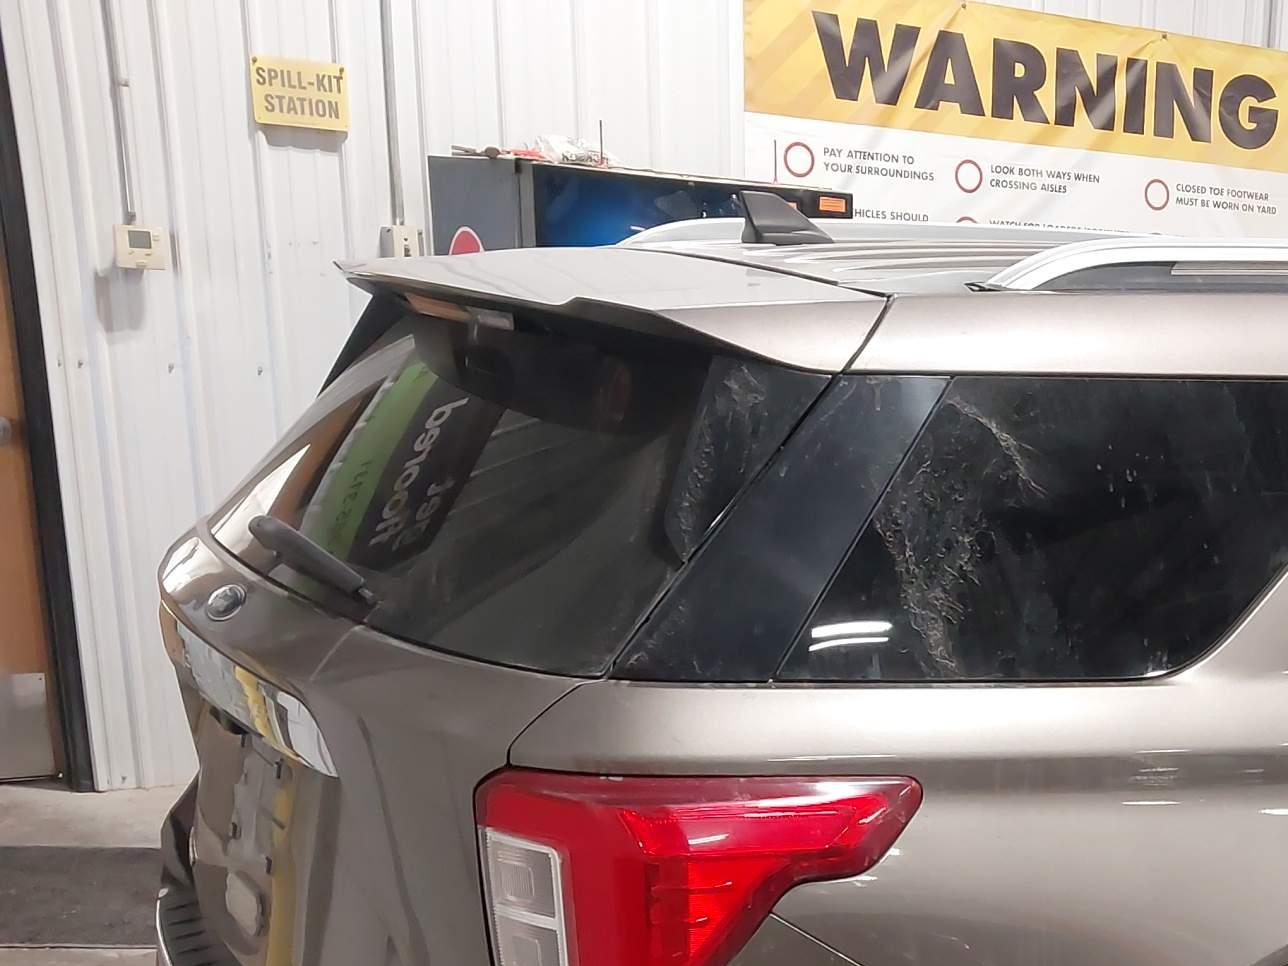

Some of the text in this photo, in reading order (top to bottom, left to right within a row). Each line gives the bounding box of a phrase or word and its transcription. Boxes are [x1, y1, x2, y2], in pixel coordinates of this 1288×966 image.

[255, 66, 344, 94] SPILL-KIT
[812, 10, 1279, 150] WARNING
[264, 93, 340, 119] STATION
[823, 147, 915, 165] PAY ATTENTION TO
[823, 162, 935, 181] YOUR SURROUNDINGS
[990, 164, 1100, 183] LOOK BOTH WAYS WHEN
[989, 178, 1067, 193] CROSSING AISLES
[1176, 183, 1269, 201] CLOSED TOE FOOTWEAR
[1176, 196, 1277, 215] MUST BE WORN ON YARD
[853, 209, 929, 222] HICLES SHOULD
